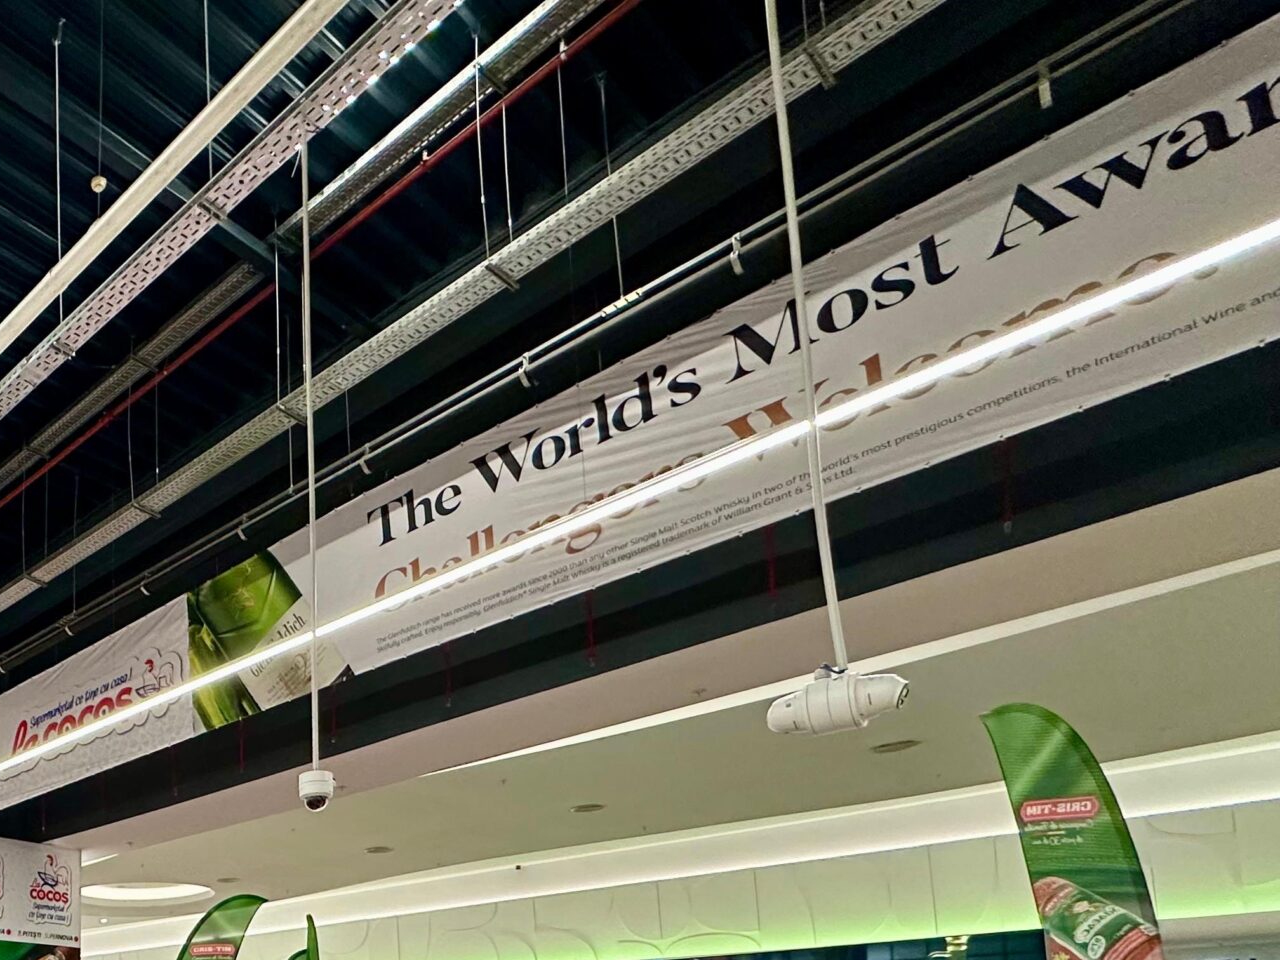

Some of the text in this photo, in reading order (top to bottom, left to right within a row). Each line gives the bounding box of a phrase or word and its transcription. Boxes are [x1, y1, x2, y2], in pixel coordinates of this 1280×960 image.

[366, 77, 1280, 547] The World's Most Awar
[441, 610, 454, 618] has
[453, 598, 481, 614] received
[482, 592, 501, 603] more
[502, 581, 528, 595] awards
[527, 573, 548, 586] since
[569, 557, 588, 570] than
[588, 552, 605, 563] any
[605, 541, 629, 555] other
[630, 530, 658, 545] Single
[658, 521, 678, 535] Malt
[680, 509, 712, 527] Scotch
[713, 495, 750, 514] Whisky
[751, 490, 762, 500] in
[763, 483, 784, 495] two
[785, 473, 797, 487] of
[861, 440, 892, 458] most
[894, 411, 965, 447] prestigious
[1065, 362, 1092, 379] the
[1094, 319, 1198, 367] International
[1201, 302, 1247, 324] Wine
[527, 583, 552, 596] Single
[552, 575, 570, 586] Malt
[570, 563, 601, 579] Whisky
[601, 560, 610, 568] is
[616, 541, 660, 562] registered
[661, 522, 710, 545] trademark
[711, 515, 722, 526] of
[723, 503, 761, 521] William
[762, 490, 793, 506] Grant
[794, 486, 803, 495] &
[805, 475, 832, 491] Sns
